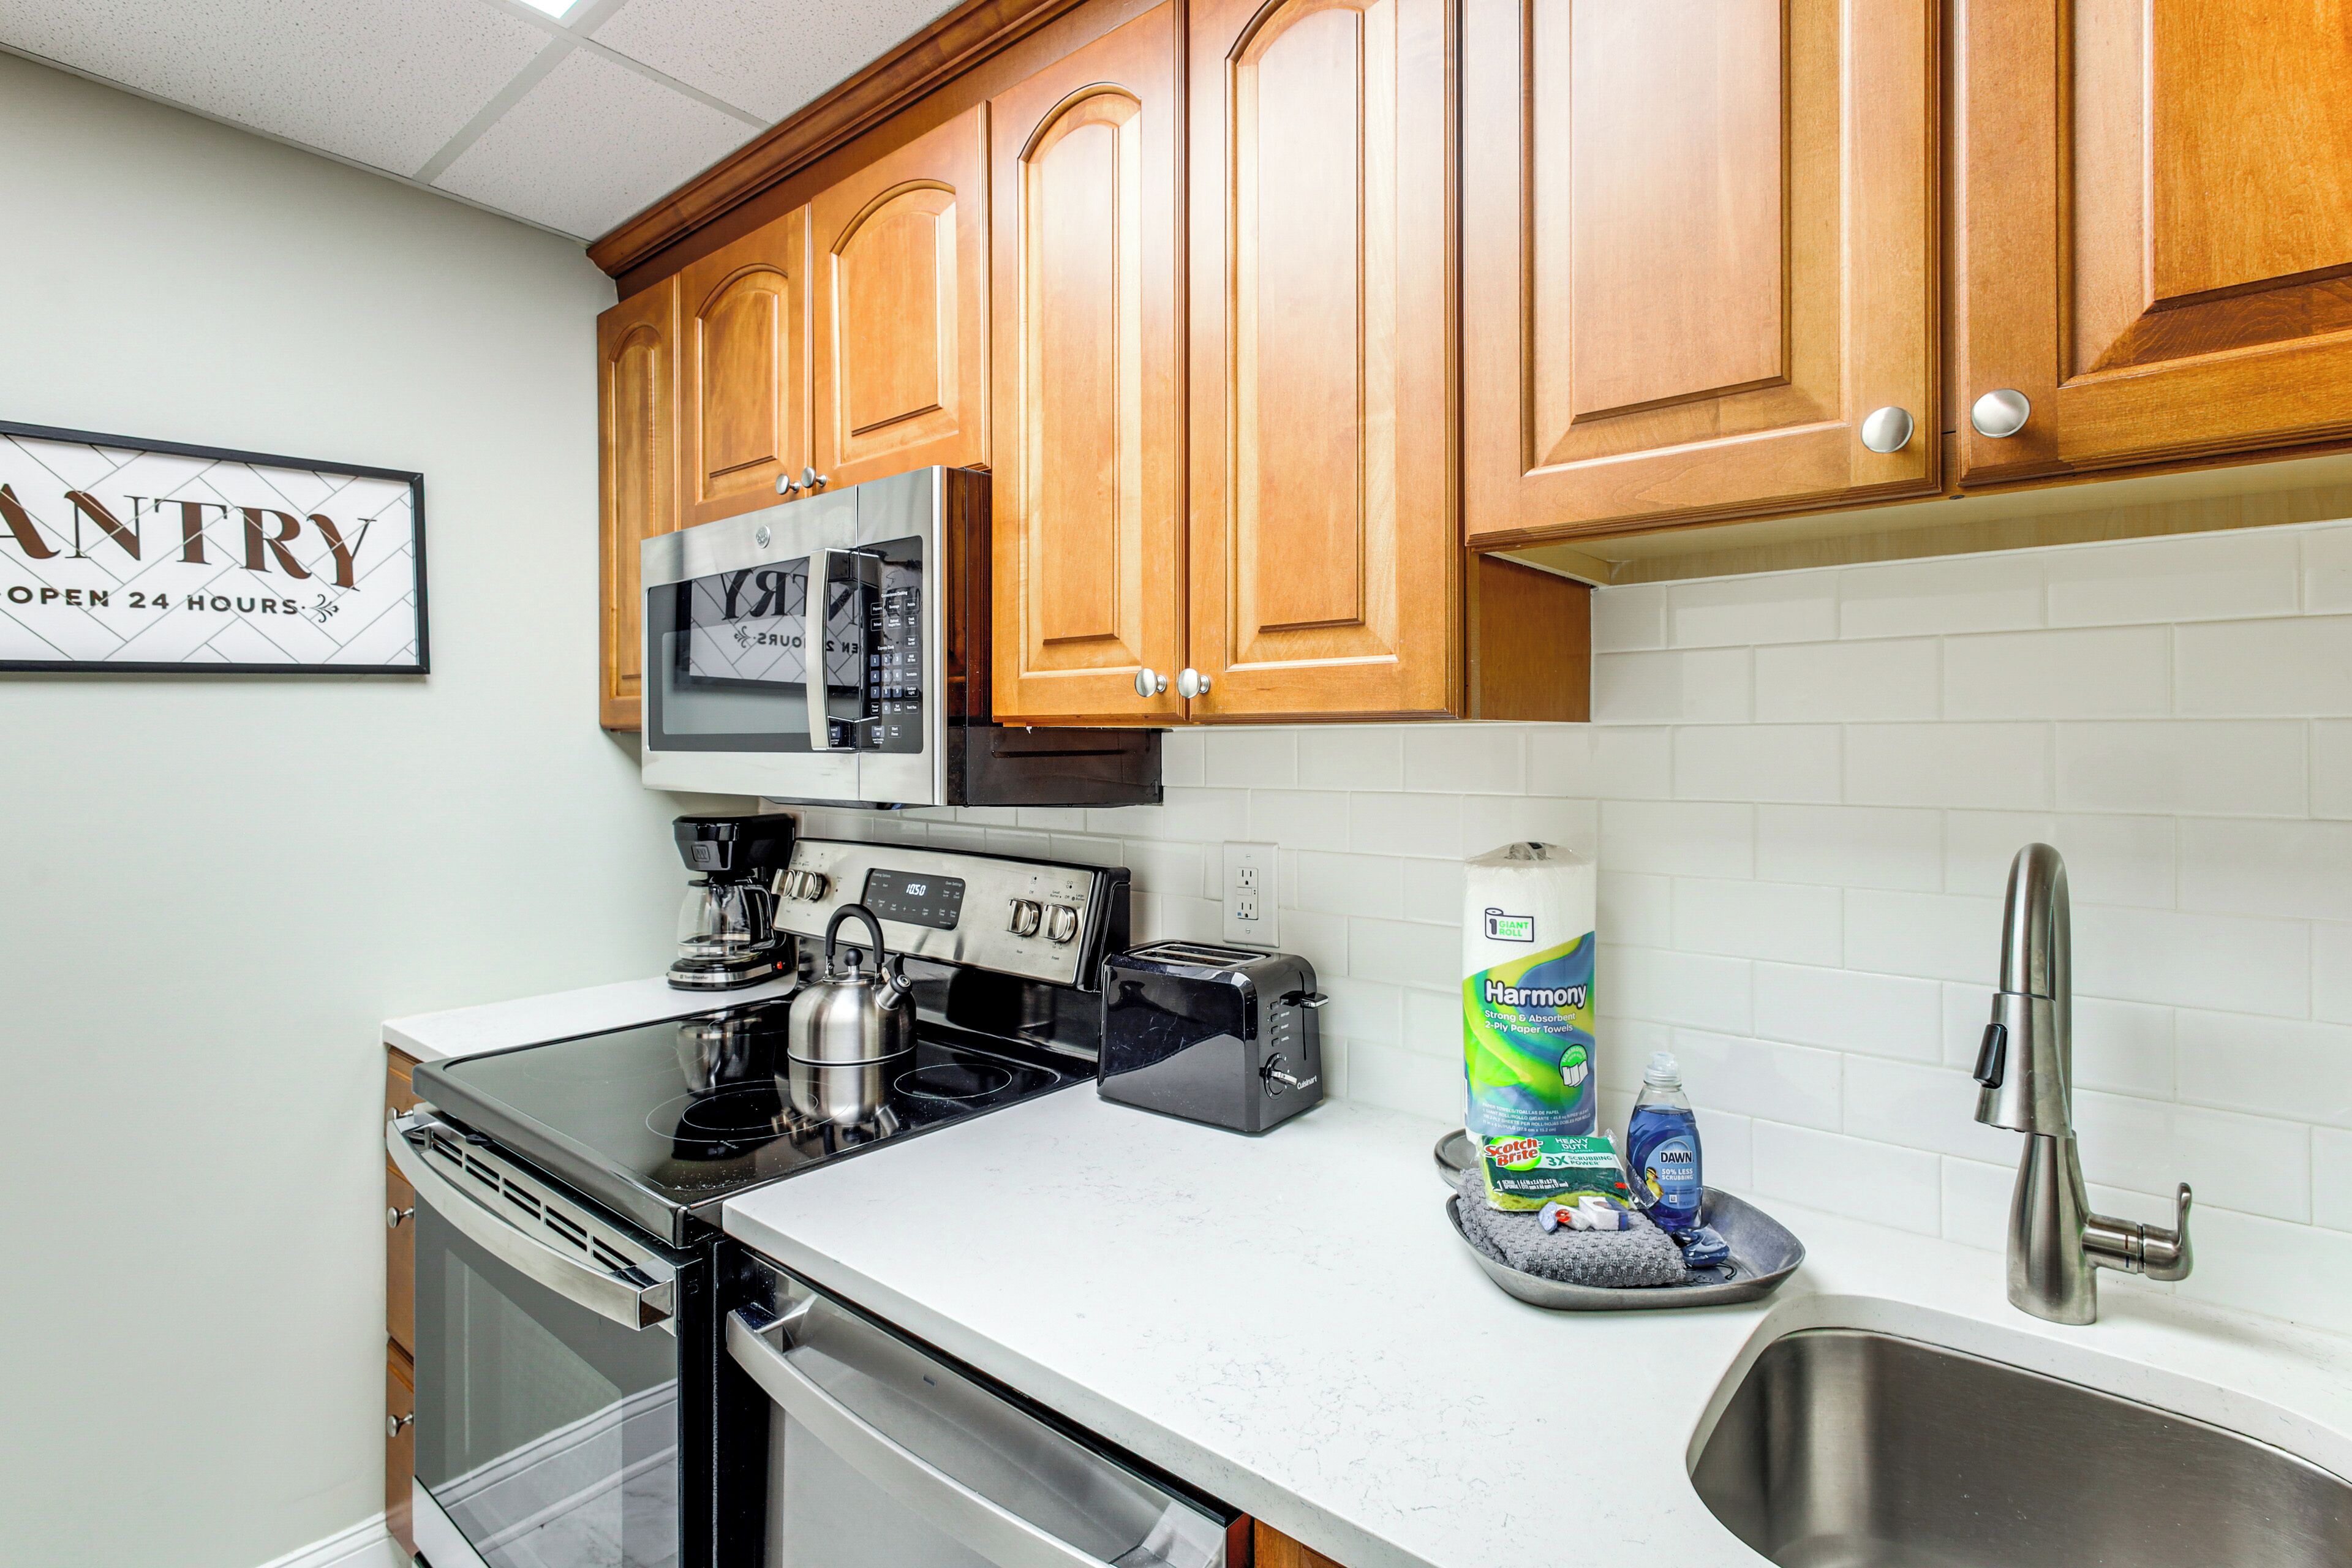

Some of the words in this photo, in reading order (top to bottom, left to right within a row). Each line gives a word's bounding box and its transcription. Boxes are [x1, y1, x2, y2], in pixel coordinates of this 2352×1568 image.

[7, 586, 109, 606] OPEN
[129, 592, 169, 609] 24
[187, 595, 298, 614] HOURS
[1490, 919, 1497, 935] 1
[1499, 921, 1529, 929] GIANT
[1485, 979, 1587, 1008] Harmony
[1485, 1010, 1516, 1022] Strong
[1529, 1013, 1575, 1022] Absorbent
[1485, 1021, 1508, 1032] 2-Ply
[1511, 1025, 1540, 1034] Paper
[1544, 1024, 1573, 1033] Towels
[1297, 1075, 1317, 1090] Cuisinart
[1496, 1149, 1538, 1166] Brite
[1546, 1156, 1569, 1166] 3X
[1660, 1152, 1692, 1163] DAWN
